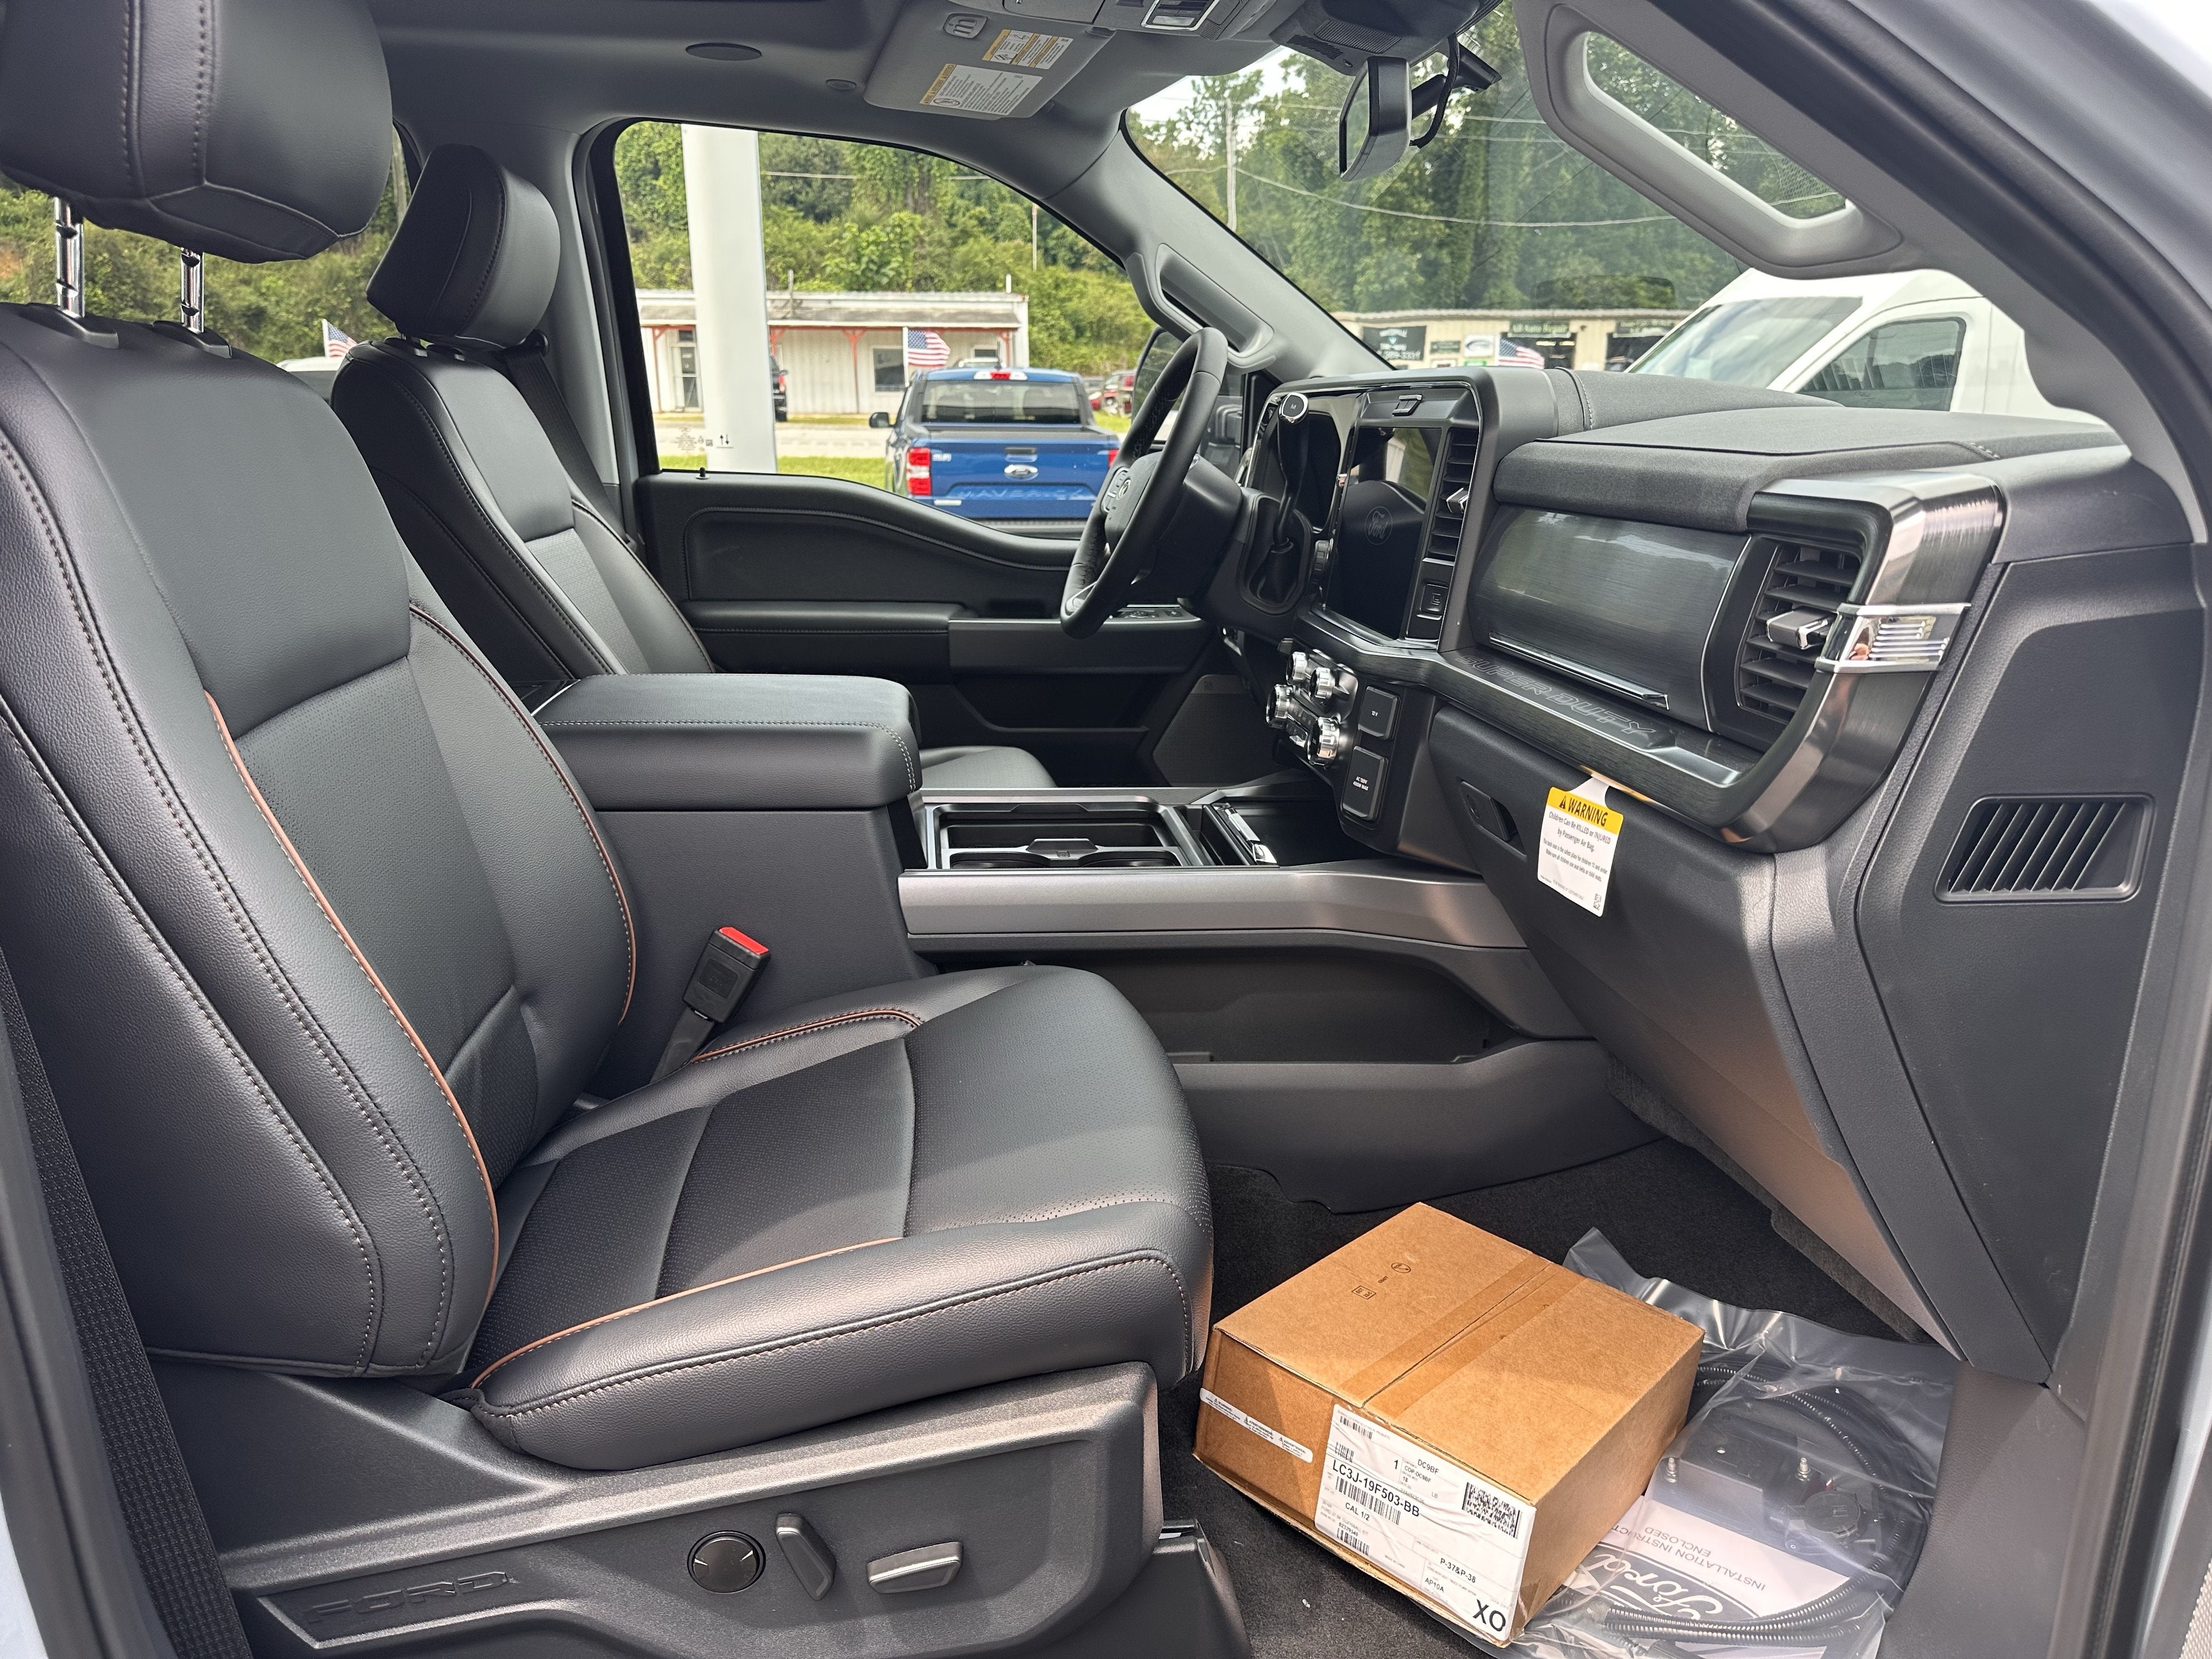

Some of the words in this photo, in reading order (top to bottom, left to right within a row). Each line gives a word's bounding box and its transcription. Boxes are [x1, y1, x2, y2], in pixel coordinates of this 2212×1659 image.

[1455, 656, 1552, 696] SUPER
[1546, 693, 1657, 734] DUTY
[1568, 798, 1608, 827] WARNING
[1558, 827, 1562, 837] by
[1562, 830, 1580, 845] Passenger
[1576, 823, 1589, 834] KILLED
[1594, 832, 1611, 844] INJURED
[1394, 1459, 1398, 1470] 1
[1418, 1459, 1439, 1474] DC9BF
[1333, 1459, 1419, 1517] LC3J-19F503-BB
[1345, 1502, 1359, 1515] CAL
[1361, 1511, 1370, 1521] 1/2
[1645, 1527, 1712, 1557] ENCLOSED
[1425, 1577, 1444, 1592] AP10A
[1440, 1558, 1476, 1583] P-37&P-38
[1676, 1550, 1765, 1591] INSTALLATION
[304, 1571, 509, 1624] FORD
[1585, 1553, 1723, 1621] Ford
[1472, 1599, 1506, 1632] XO
